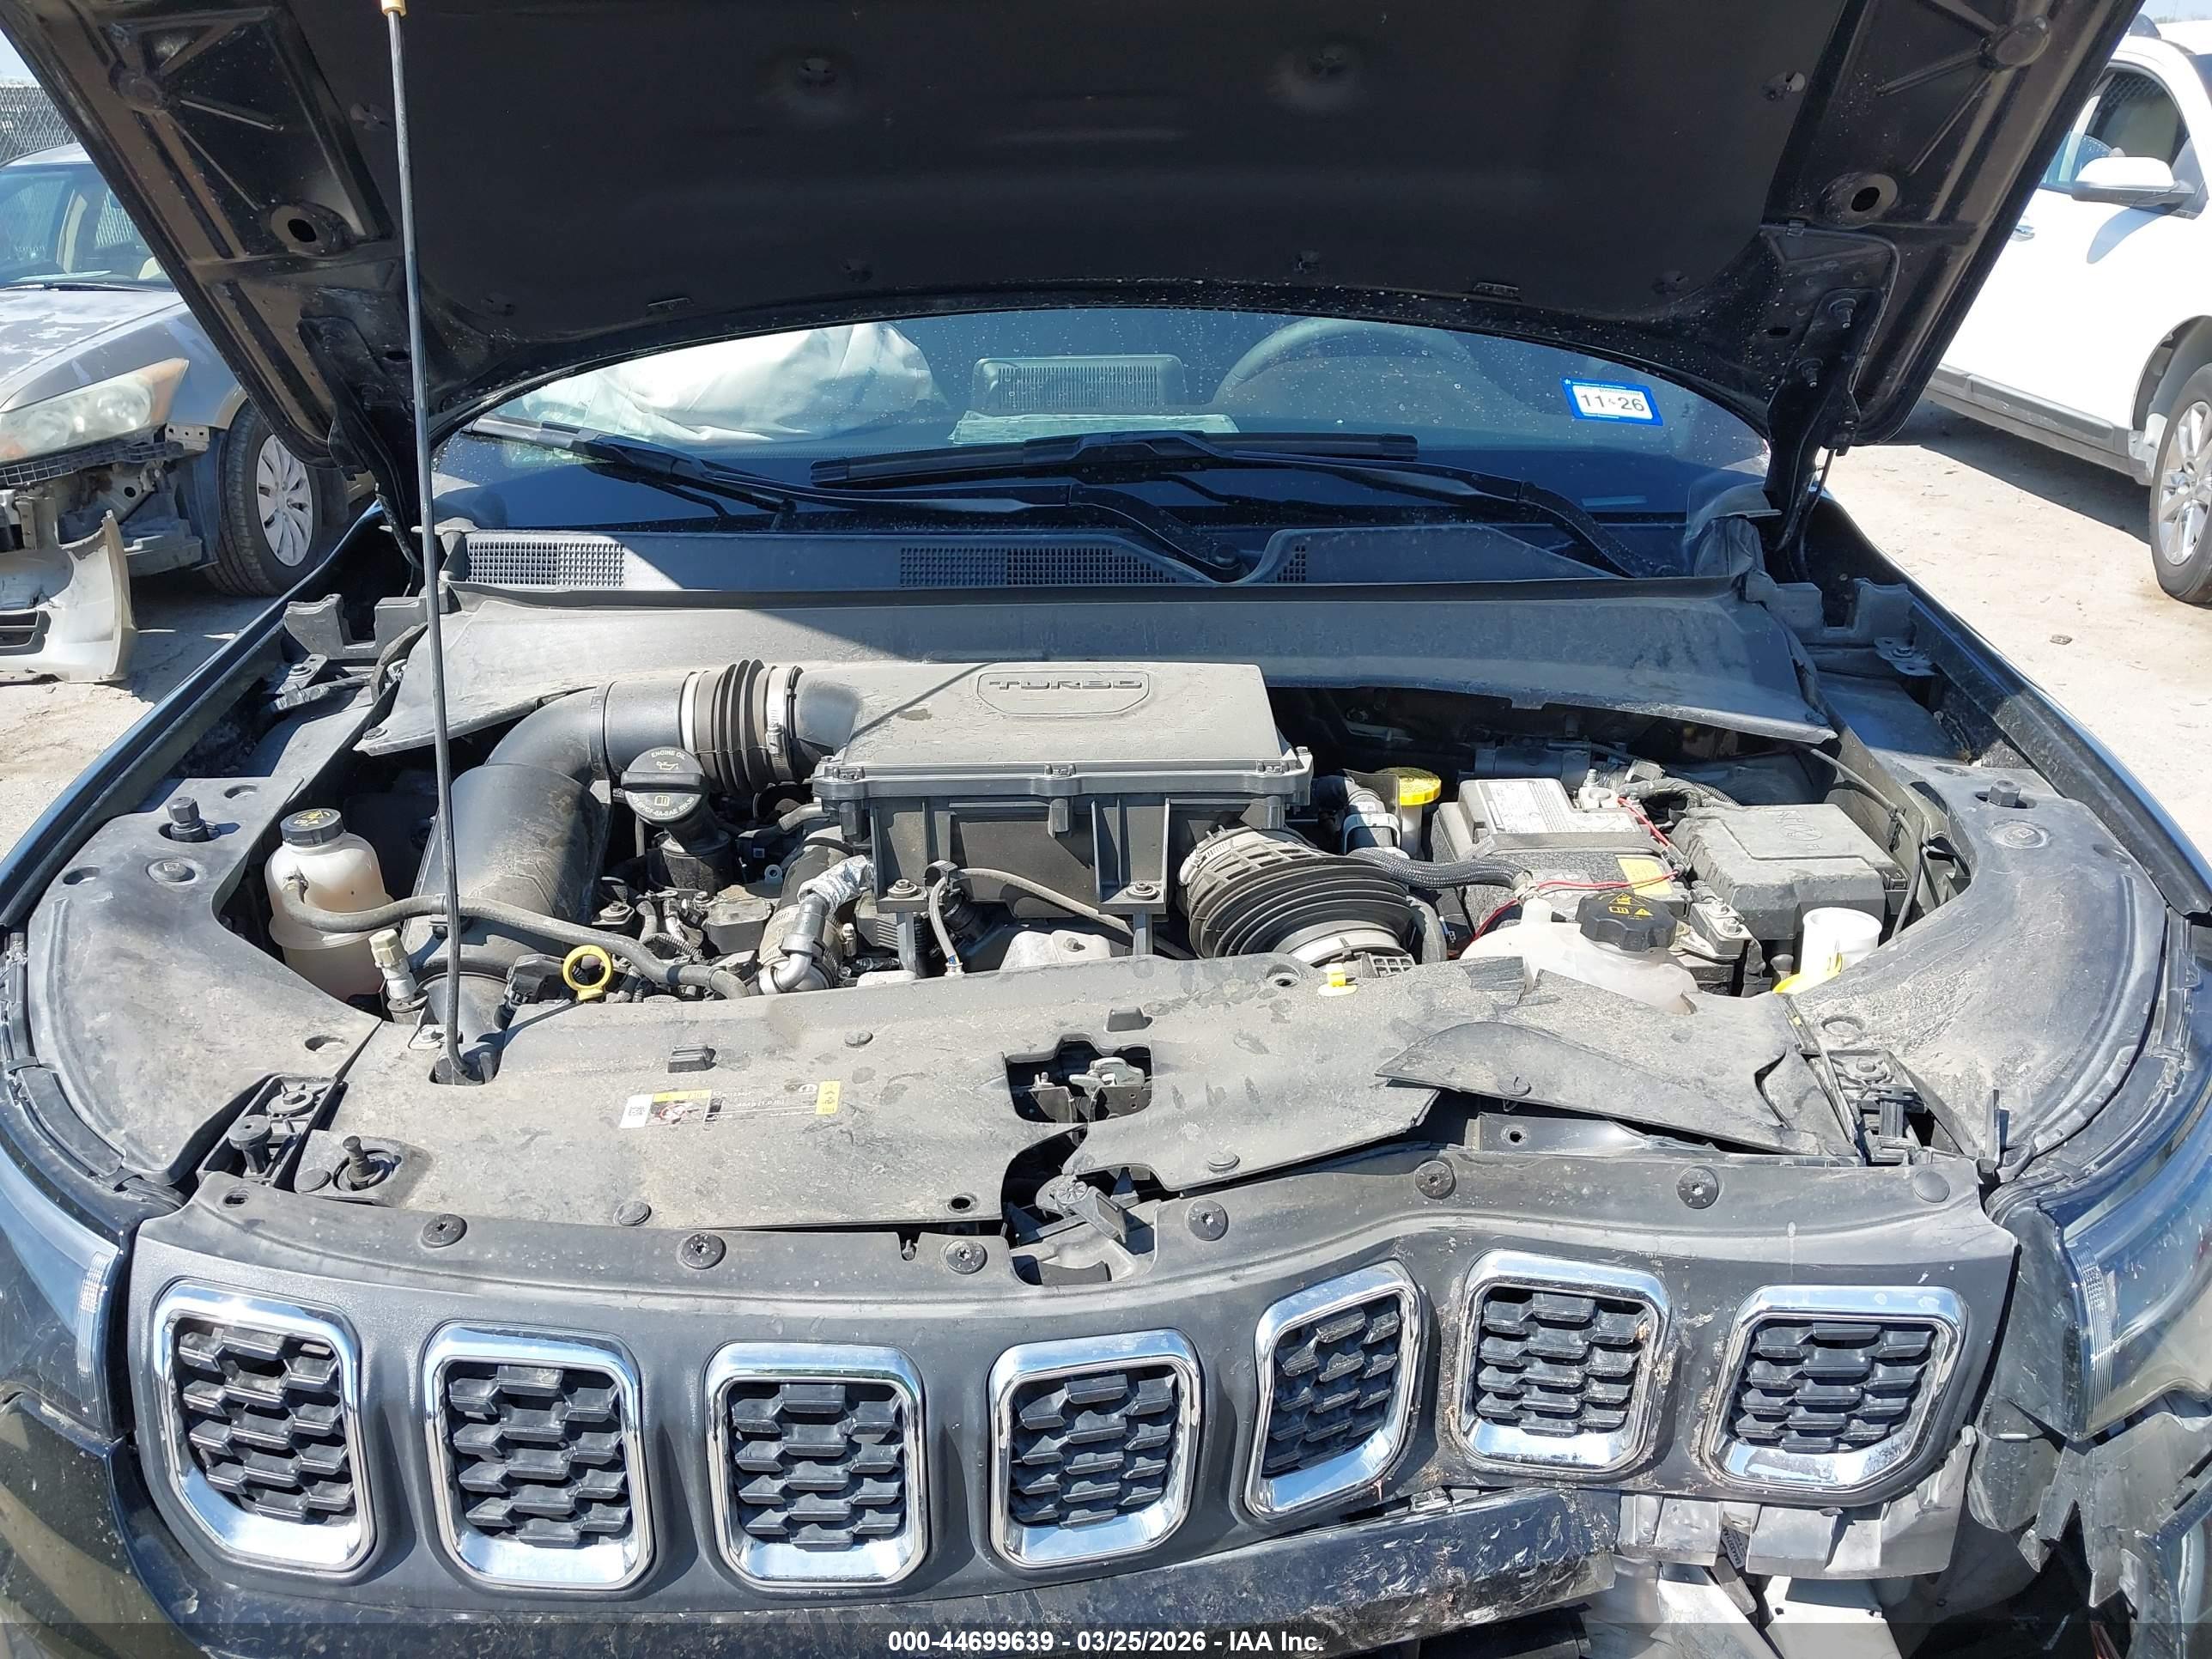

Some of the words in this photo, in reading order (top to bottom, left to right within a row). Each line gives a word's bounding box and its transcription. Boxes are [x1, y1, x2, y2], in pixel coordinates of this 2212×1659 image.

[1581, 394, 1604, 408] 11
[1618, 397, 1644, 412] 26
[989, 679, 1142, 690] TURBO
[676, 751, 685, 760] OIL
